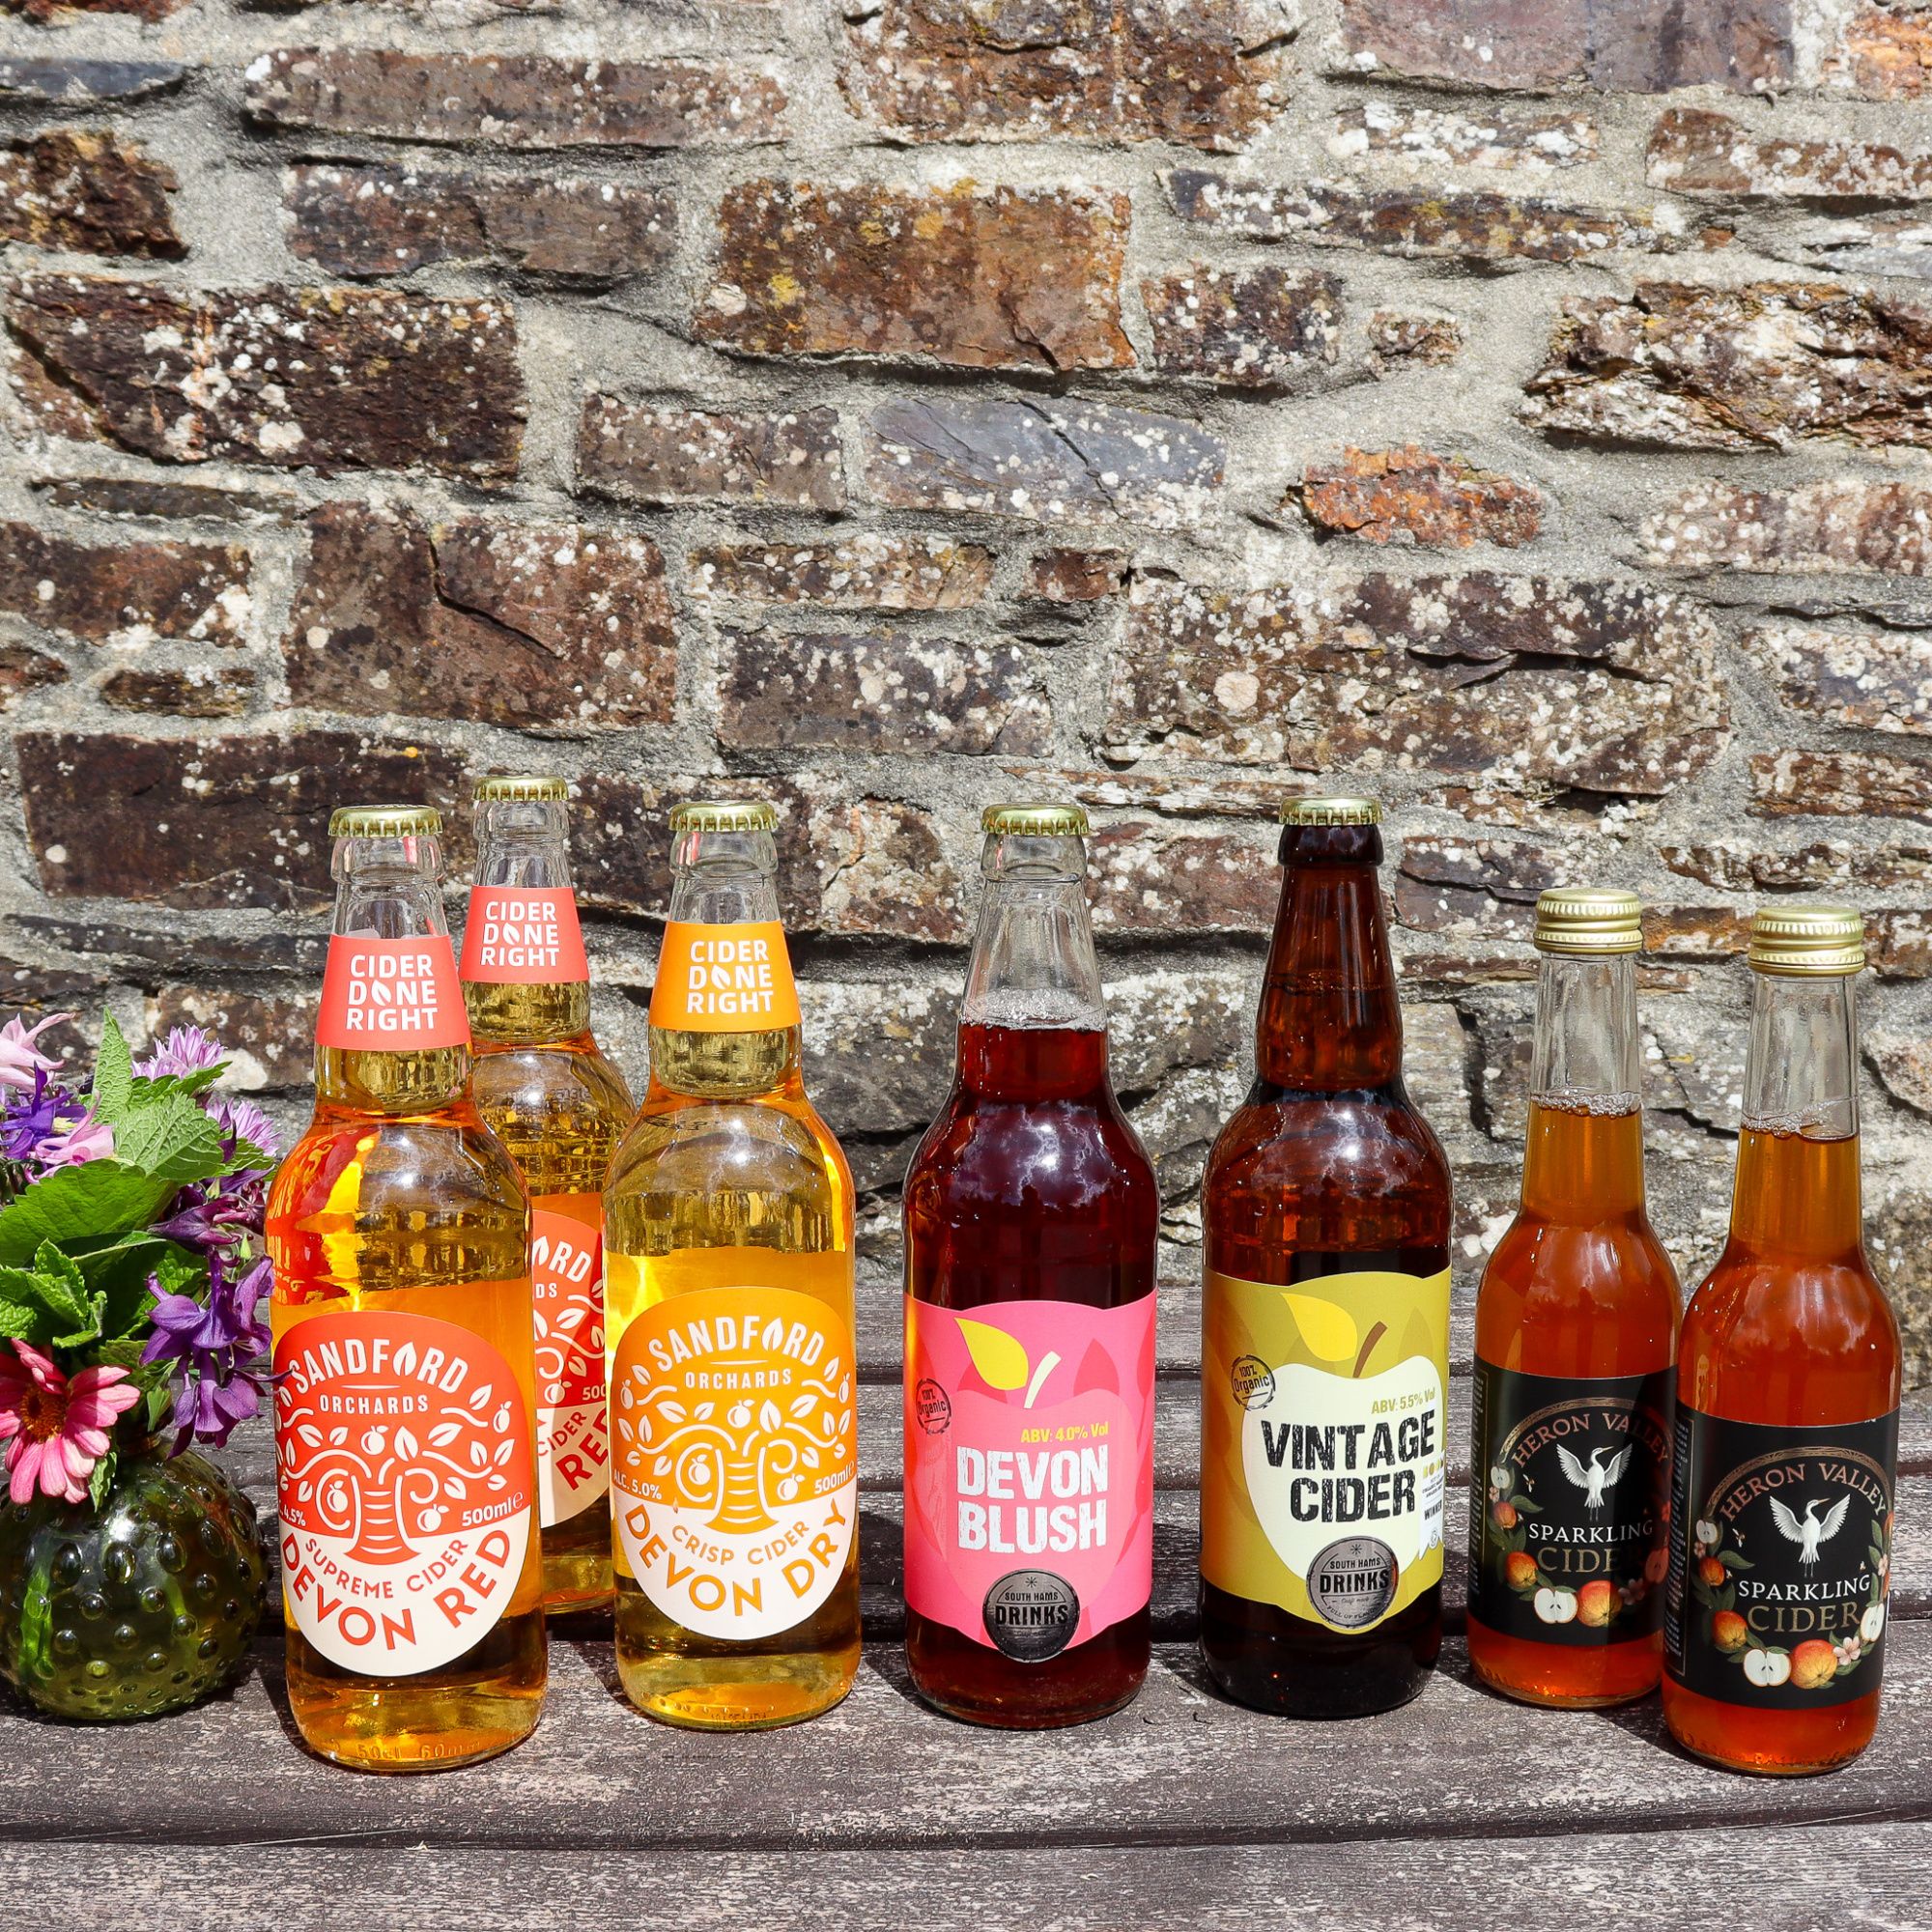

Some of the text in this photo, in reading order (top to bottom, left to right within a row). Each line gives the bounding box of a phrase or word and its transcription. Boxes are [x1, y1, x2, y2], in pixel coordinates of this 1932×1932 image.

[485, 900, 556, 922] CIDER
[482, 923, 559, 947] DONE
[480, 947, 560, 967] RIGHT
[690, 939, 769, 963] CIDER
[350, 954, 434, 979] CIDER
[688, 964, 774, 990] DONE
[348, 979, 438, 1007] DONE
[686, 990, 774, 1014] RIGHT
[346, 1008, 439, 1032] RIGHT
[685, 1368, 792, 1390] ORCHARDS
[1234, 1376, 1270, 1394] Organic
[320, 1394, 429, 1415] ORCHARDS
[917, 1400, 947, 1418] Organic
[1055, 1427, 1088, 1441] 4.0%
[1090, 1422, 1109, 1437] Vol
[1261, 1408, 1435, 1470] VINTAGE
[1511, 1413, 1591, 1467] HERON
[956, 1444, 1108, 1500] DEVON
[632, 1479, 663, 1500] 5.0%
[1290, 1469, 1416, 1523] CIDER
[1719, 1463, 1887, 1521] HERON VALLEY
[958, 1499, 1107, 1554] BLUSH
[1528, 1520, 1654, 1544] SPARKLING
[671, 1520, 810, 1566] CRISP CIDER
[305, 1538, 469, 1599] SUPREME CIDER
[624, 1498, 846, 1616] DEVON DRY
[1329, 1557, 1380, 1570] SOUTH HAMS
[281, 1530, 511, 1650] DEVON RED
[1320, 1569, 1390, 1594] DRINKS
[1738, 1575, 1870, 1601] SPARKLING
[1005, 1591, 1059, 1602] SOUTH HAMS
[995, 1605, 1068, 1626] DRINKS
[1747, 1601, 1862, 1634] CIDER
